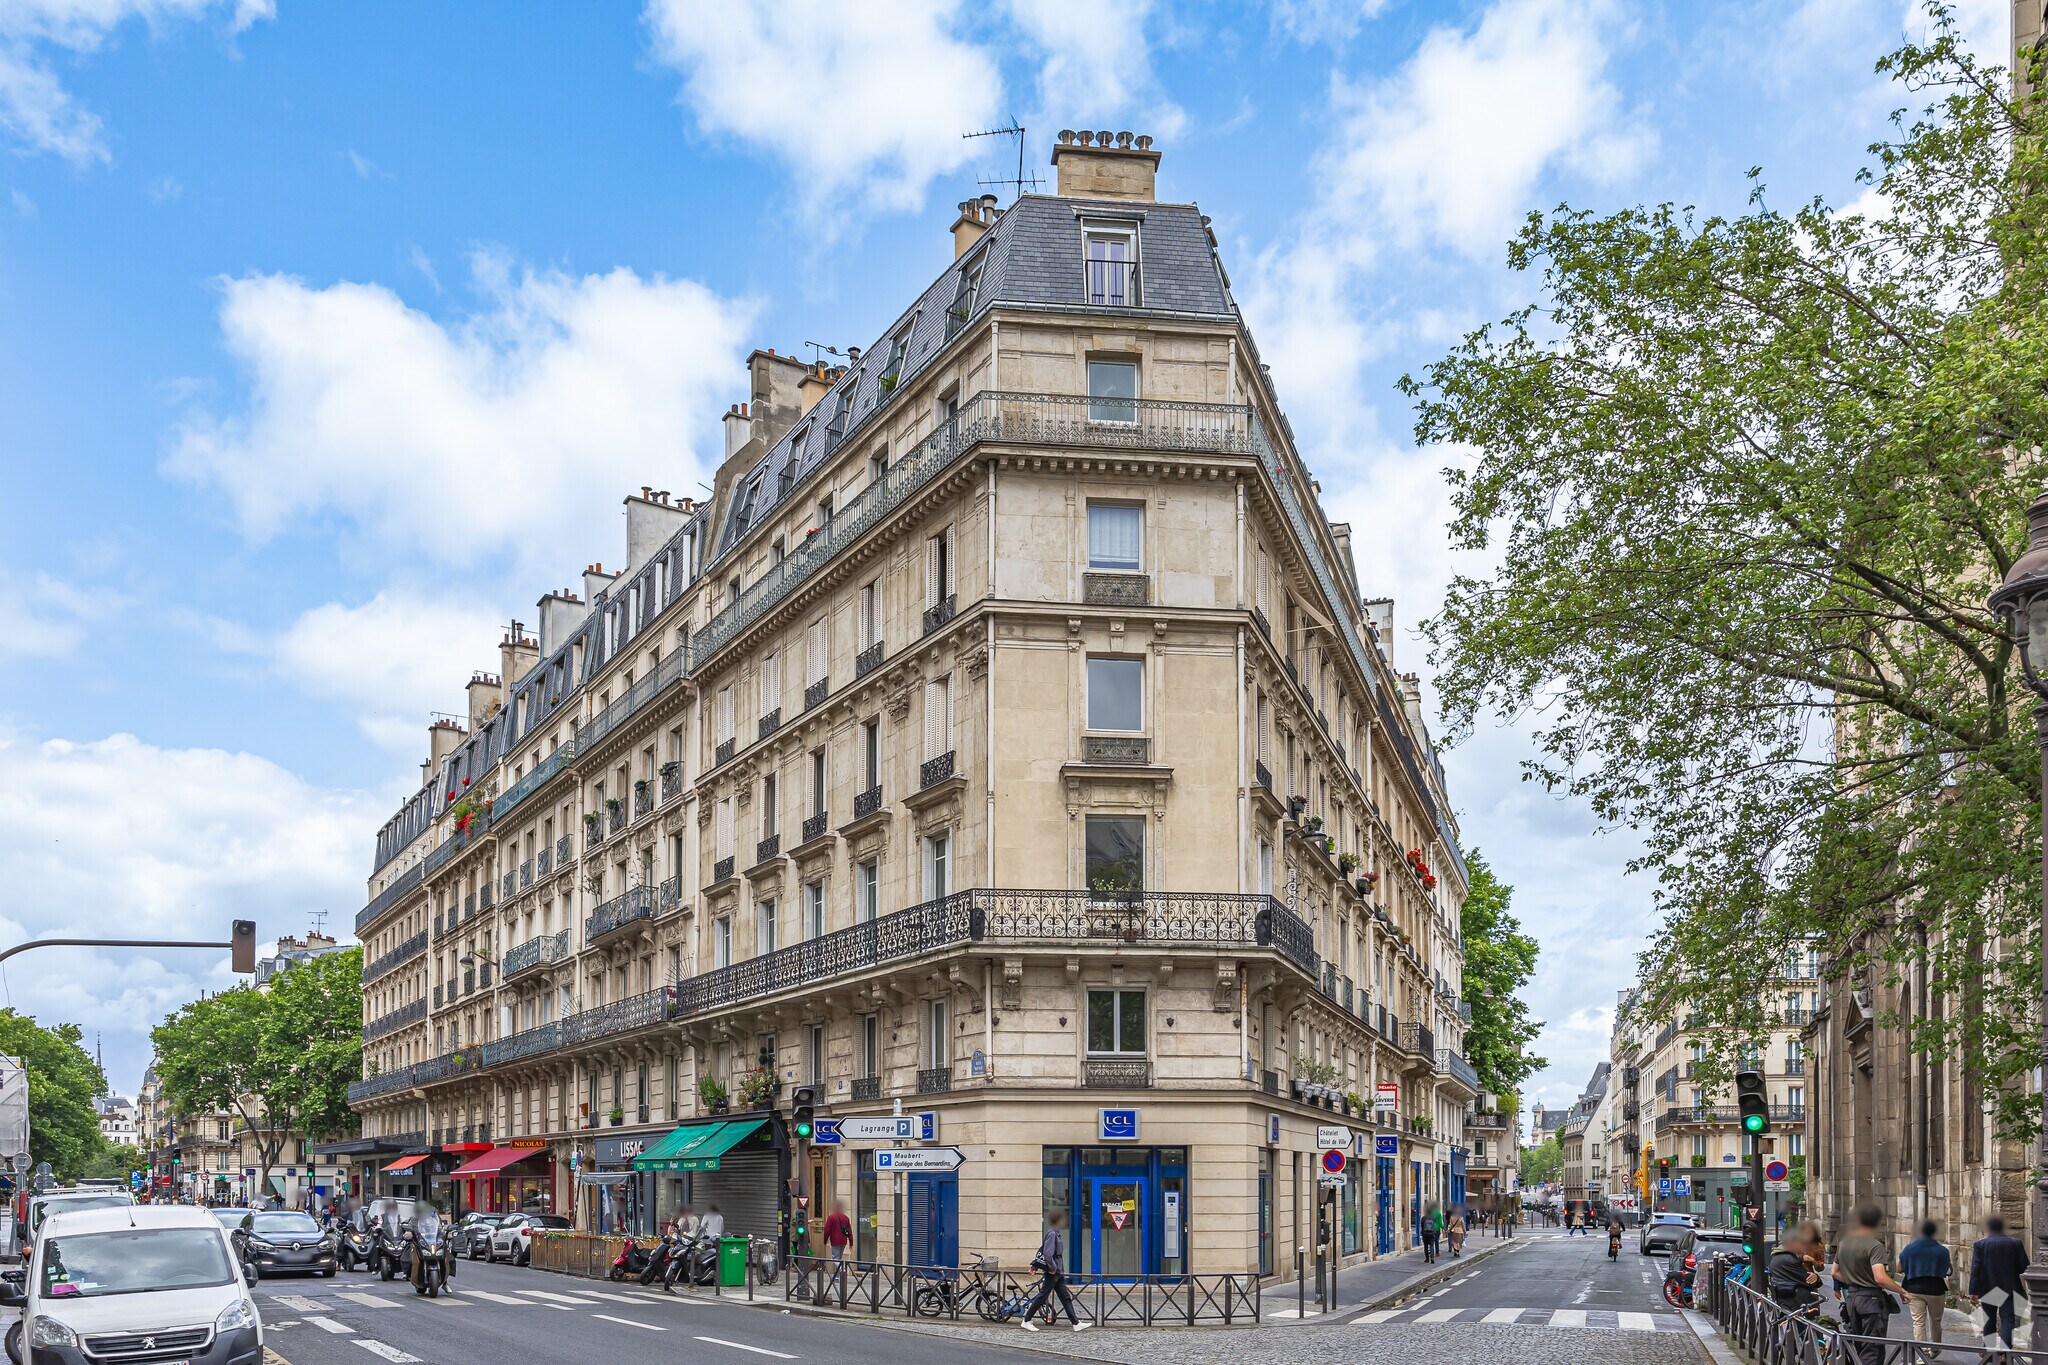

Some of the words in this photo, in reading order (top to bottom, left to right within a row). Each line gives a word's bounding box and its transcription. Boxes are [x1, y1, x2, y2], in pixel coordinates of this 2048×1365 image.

[922, 1119, 932, 1127] CL
[1106, 1116, 1131, 1125] LCL
[860, 1125, 895, 1133] Lagrange
[900, 1122, 907, 1133] P
[620, 1141, 644, 1157] LISSAC
[882, 1155, 889, 1165] P
[894, 1160, 913, 1168] Collège
